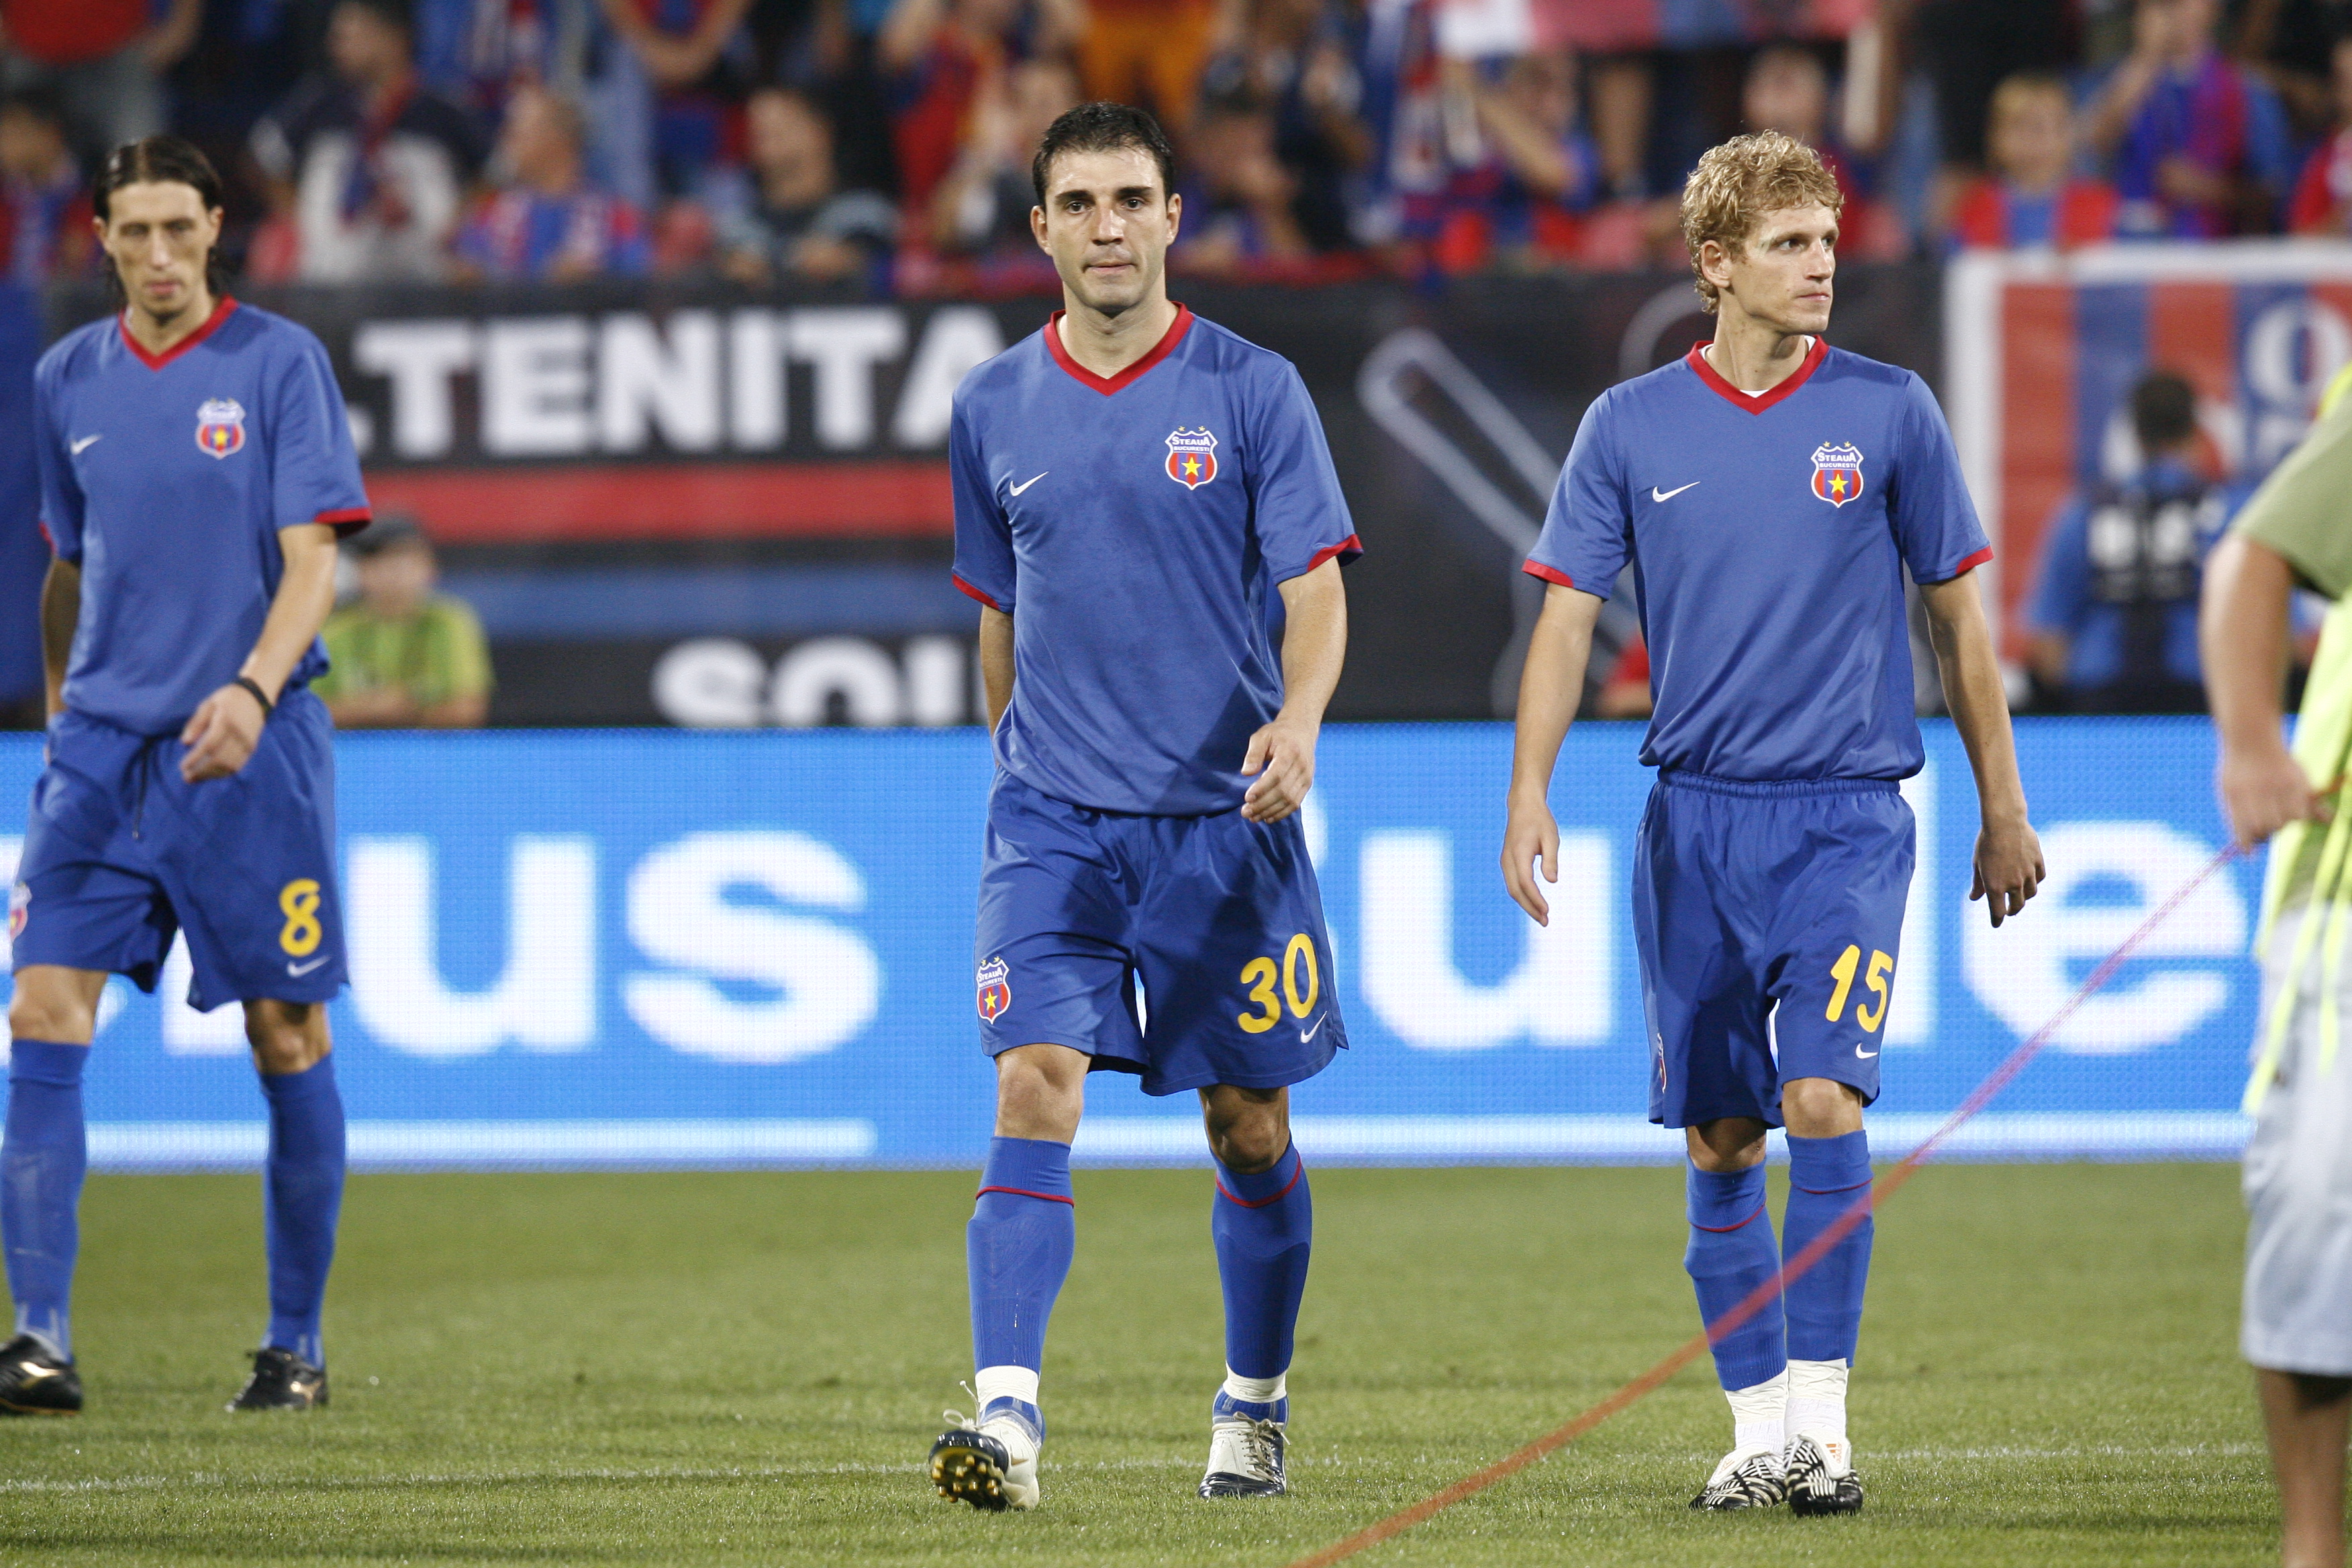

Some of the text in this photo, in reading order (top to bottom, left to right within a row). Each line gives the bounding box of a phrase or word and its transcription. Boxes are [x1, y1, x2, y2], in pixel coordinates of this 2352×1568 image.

[350, 305, 1005, 460] TENITA
[1172, 436, 1211, 446] STEAUA
[1817, 452, 1857, 462] STEAUA
[279, 878, 322, 958] 8
[1238, 933, 1319, 1034] 30
[1825, 944, 1894, 1033] 15
